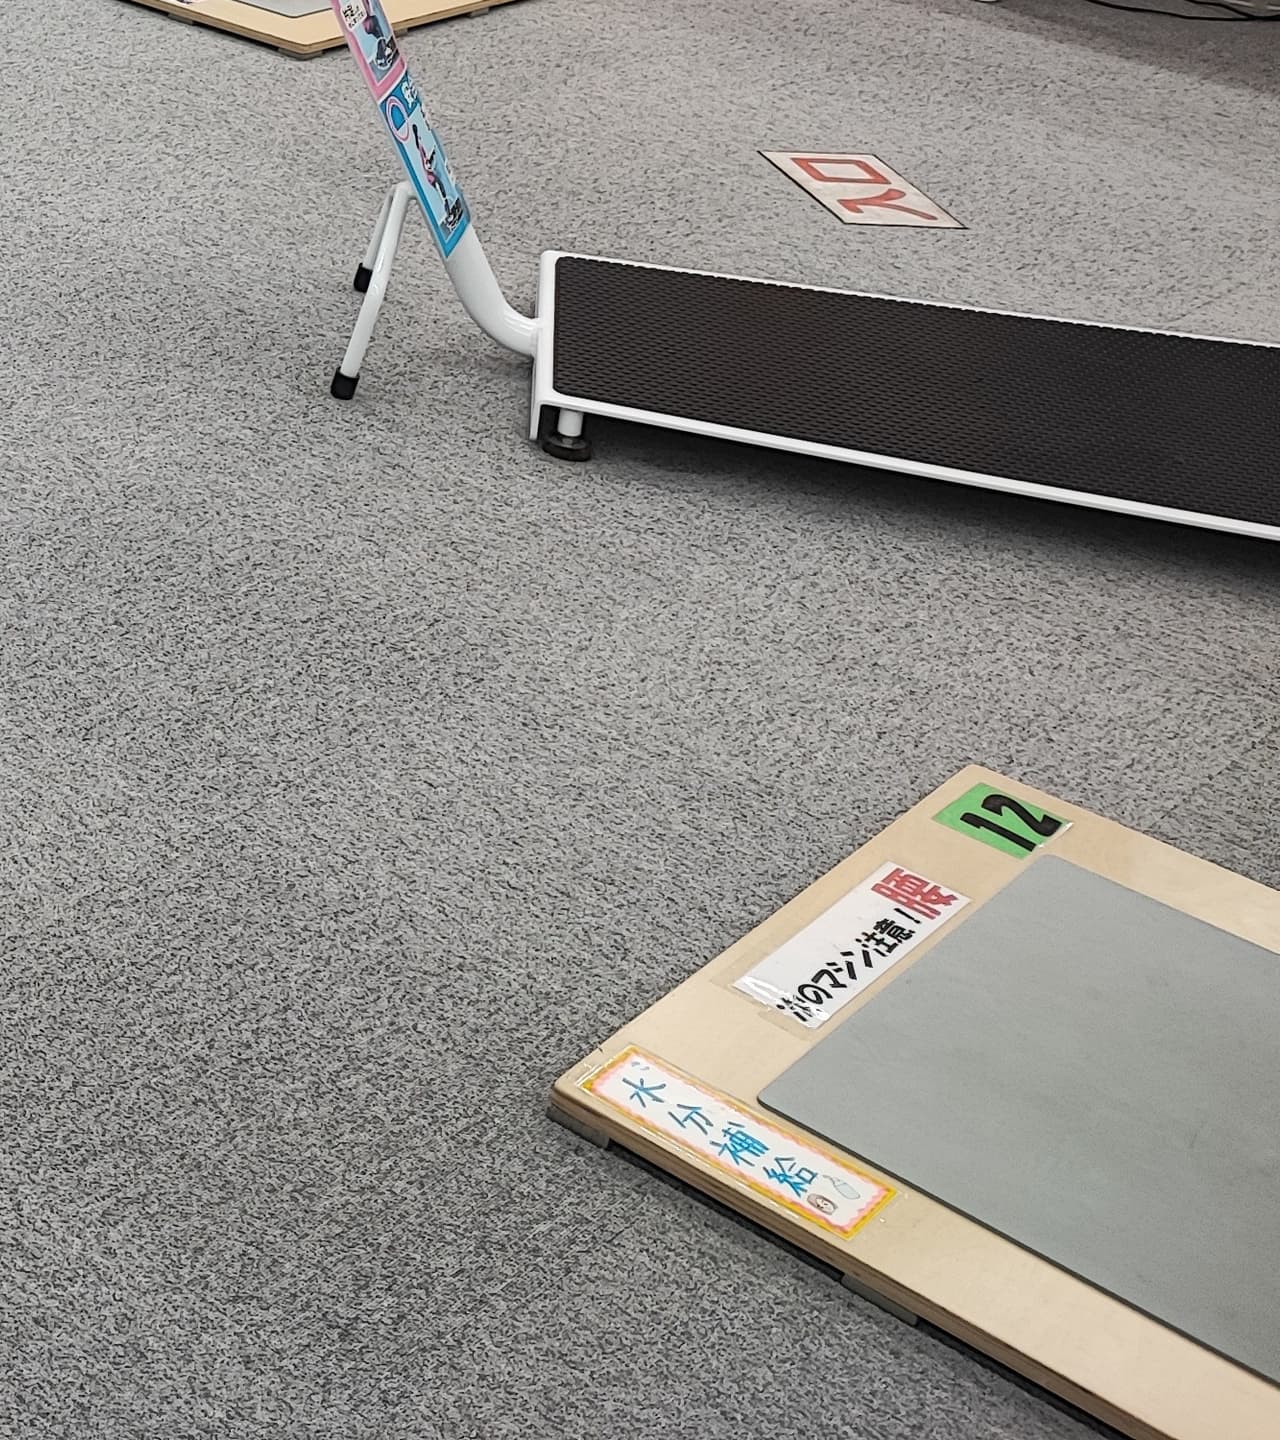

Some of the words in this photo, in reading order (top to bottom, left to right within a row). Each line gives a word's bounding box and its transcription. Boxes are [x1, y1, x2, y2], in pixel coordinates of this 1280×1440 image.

[959, 794, 1062, 852] 12
[872, 868, 959, 920] 腰
[621, 1074, 818, 1198] 水分補給
